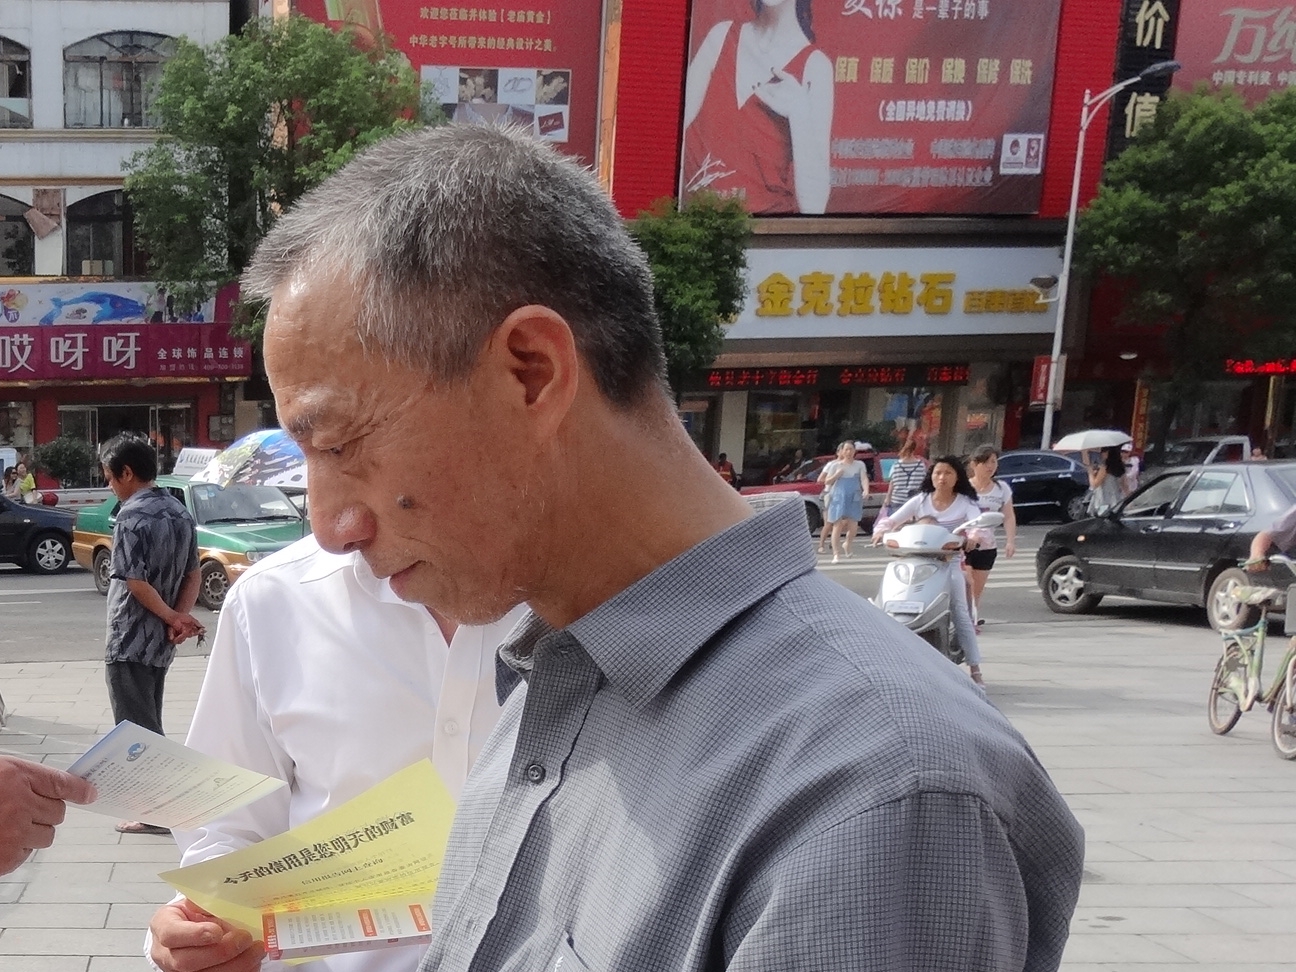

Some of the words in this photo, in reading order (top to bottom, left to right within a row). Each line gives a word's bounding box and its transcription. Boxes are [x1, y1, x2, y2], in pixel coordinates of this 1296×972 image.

[755, 271, 957, 318] 金克拉钻石
[156, 346, 245, 361] 全球饰品连锁
